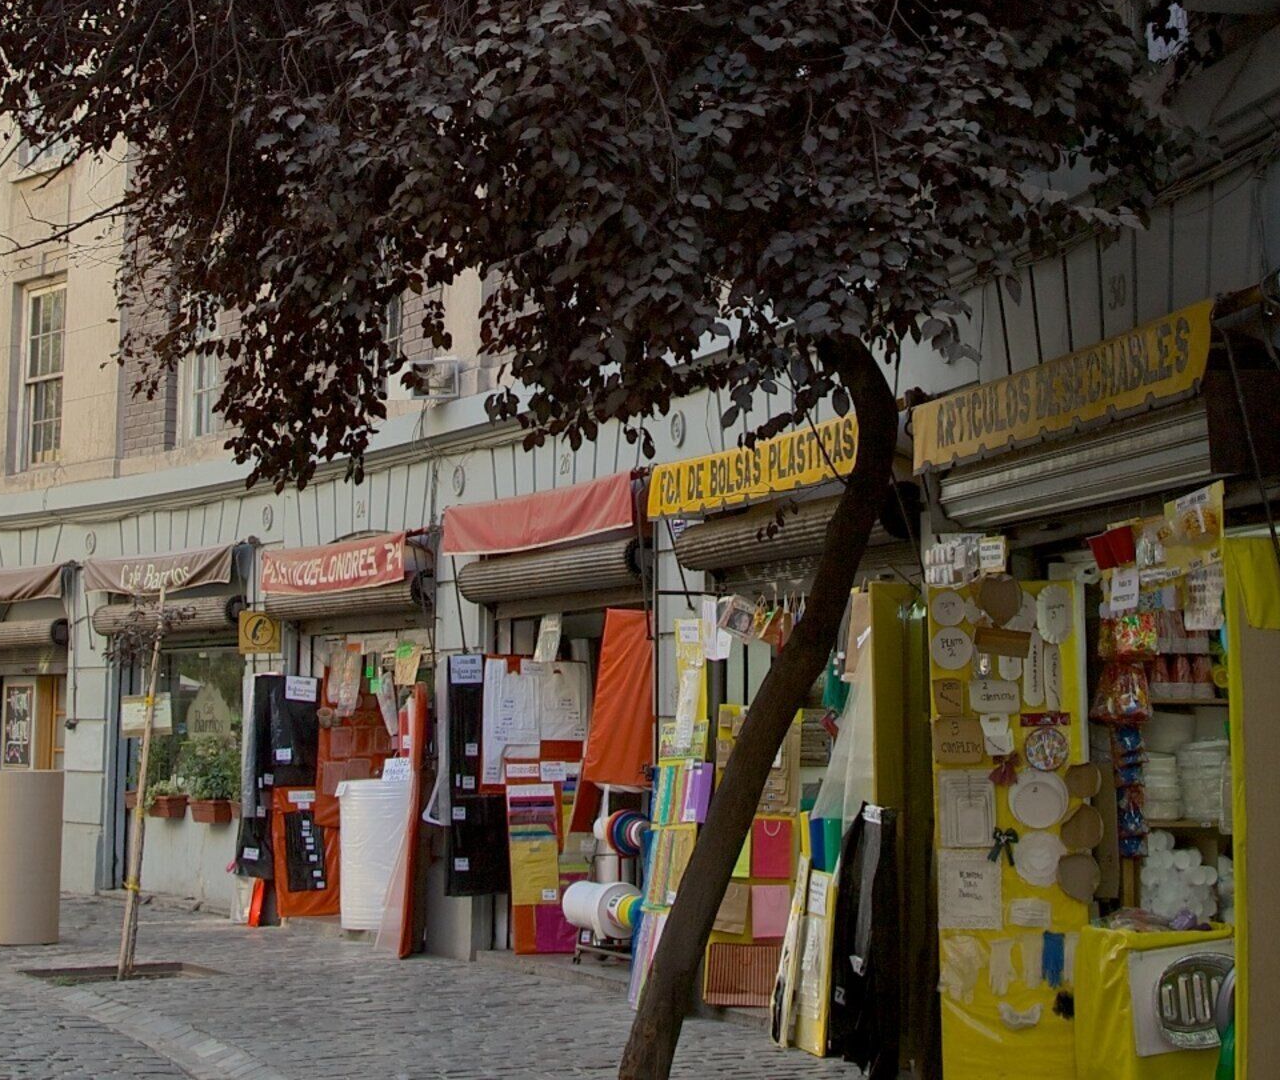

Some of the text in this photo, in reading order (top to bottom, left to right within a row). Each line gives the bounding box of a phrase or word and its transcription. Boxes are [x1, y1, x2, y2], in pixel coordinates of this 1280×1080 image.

[936, 316, 1190, 449] ARTICULOS DESECHABLES
[659, 418, 855, 507] FCA DE BOLSAS PLASTICAS
[120, 560, 190, 590] Café Barrios
[262, 539, 403, 587] PLASTICOS LONDRES 24
